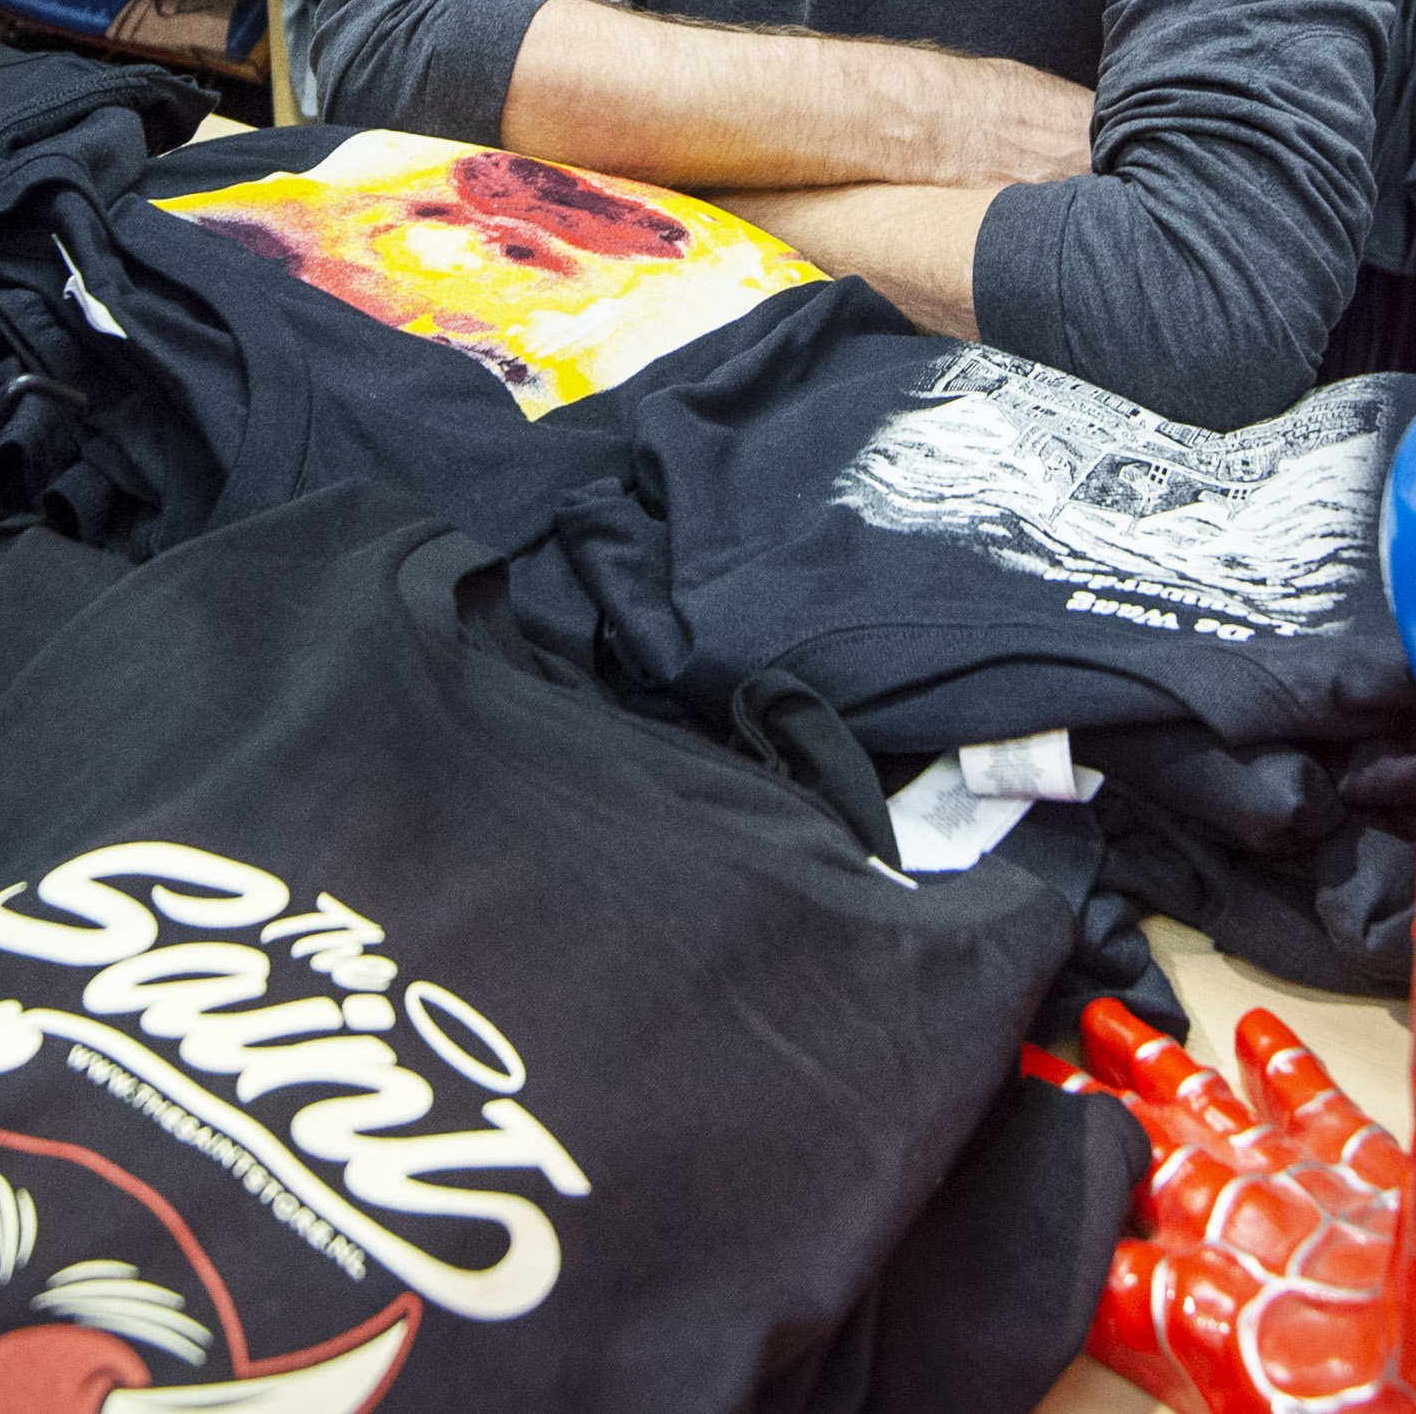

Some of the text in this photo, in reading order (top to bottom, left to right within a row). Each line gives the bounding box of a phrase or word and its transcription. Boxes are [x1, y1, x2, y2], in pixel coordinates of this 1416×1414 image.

[1065, 590, 1256, 643] De Waag
[260, 890, 399, 992] The
[66, 1042, 367, 1283] WWW.THESAINTSTORE.NL
